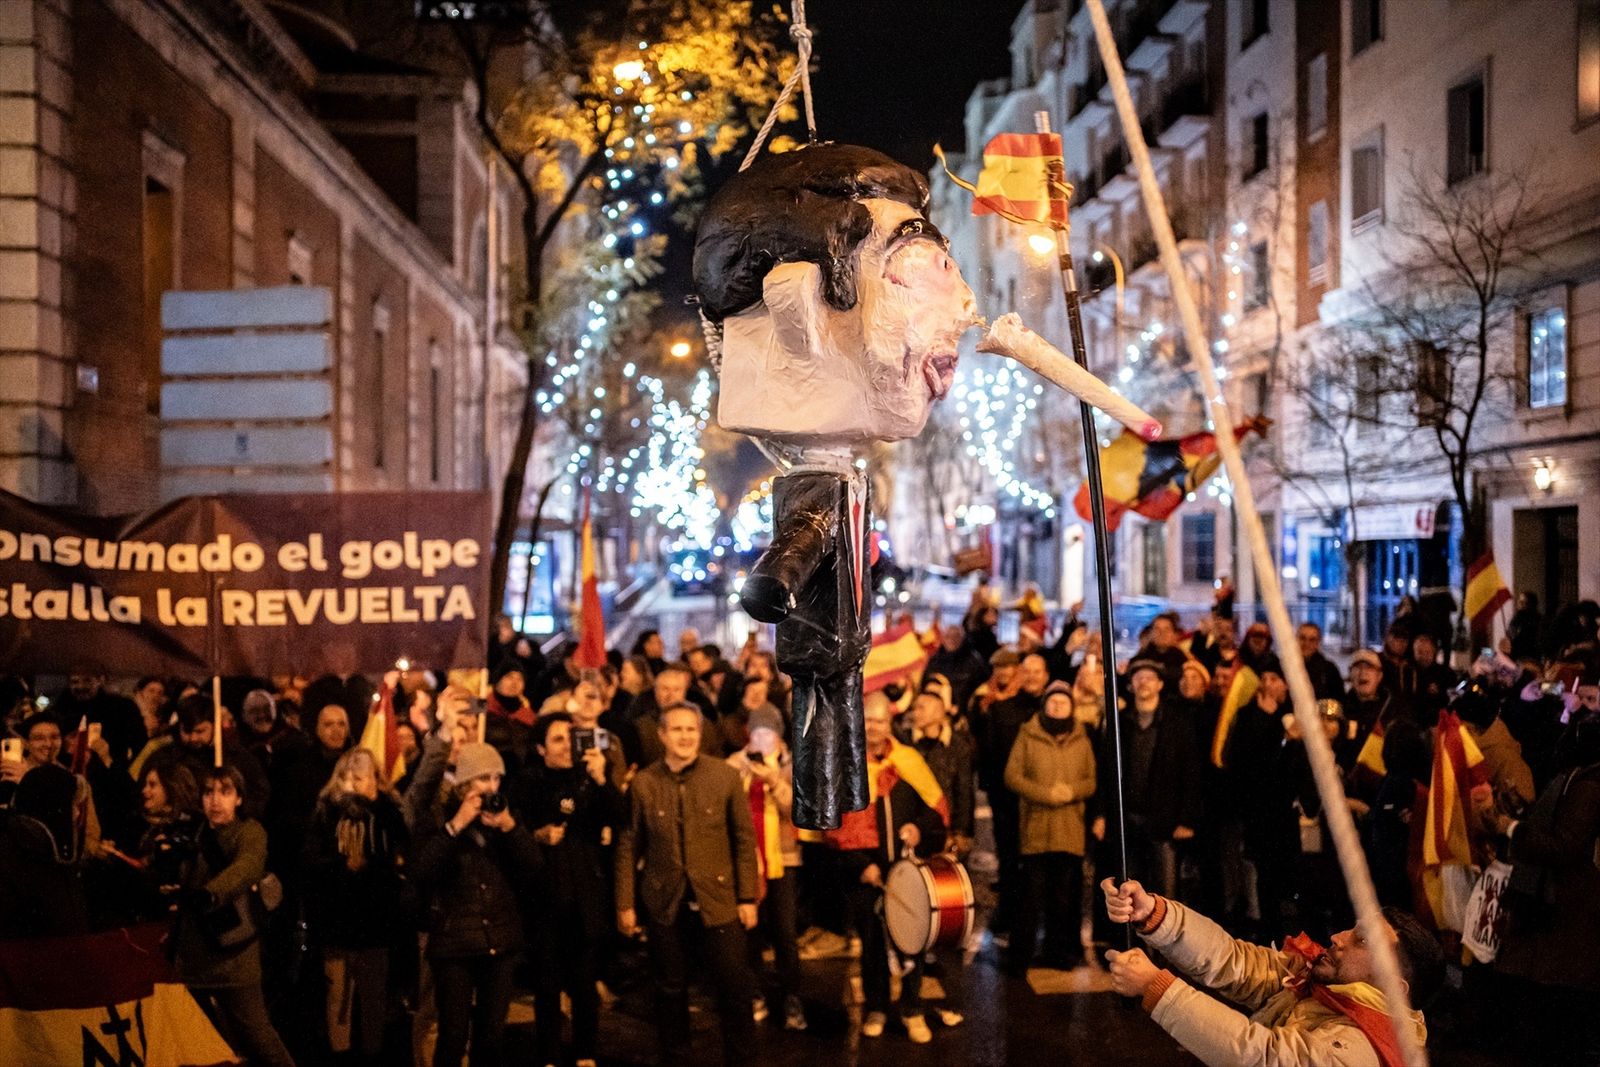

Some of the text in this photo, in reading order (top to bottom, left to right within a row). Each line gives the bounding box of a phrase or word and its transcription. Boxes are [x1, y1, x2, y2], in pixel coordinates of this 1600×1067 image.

[277, 533, 328, 572] el
[339, 531, 480, 579] golpe
[157, 588, 208, 626] la
[221, 584, 476, 626] REVUELTA
